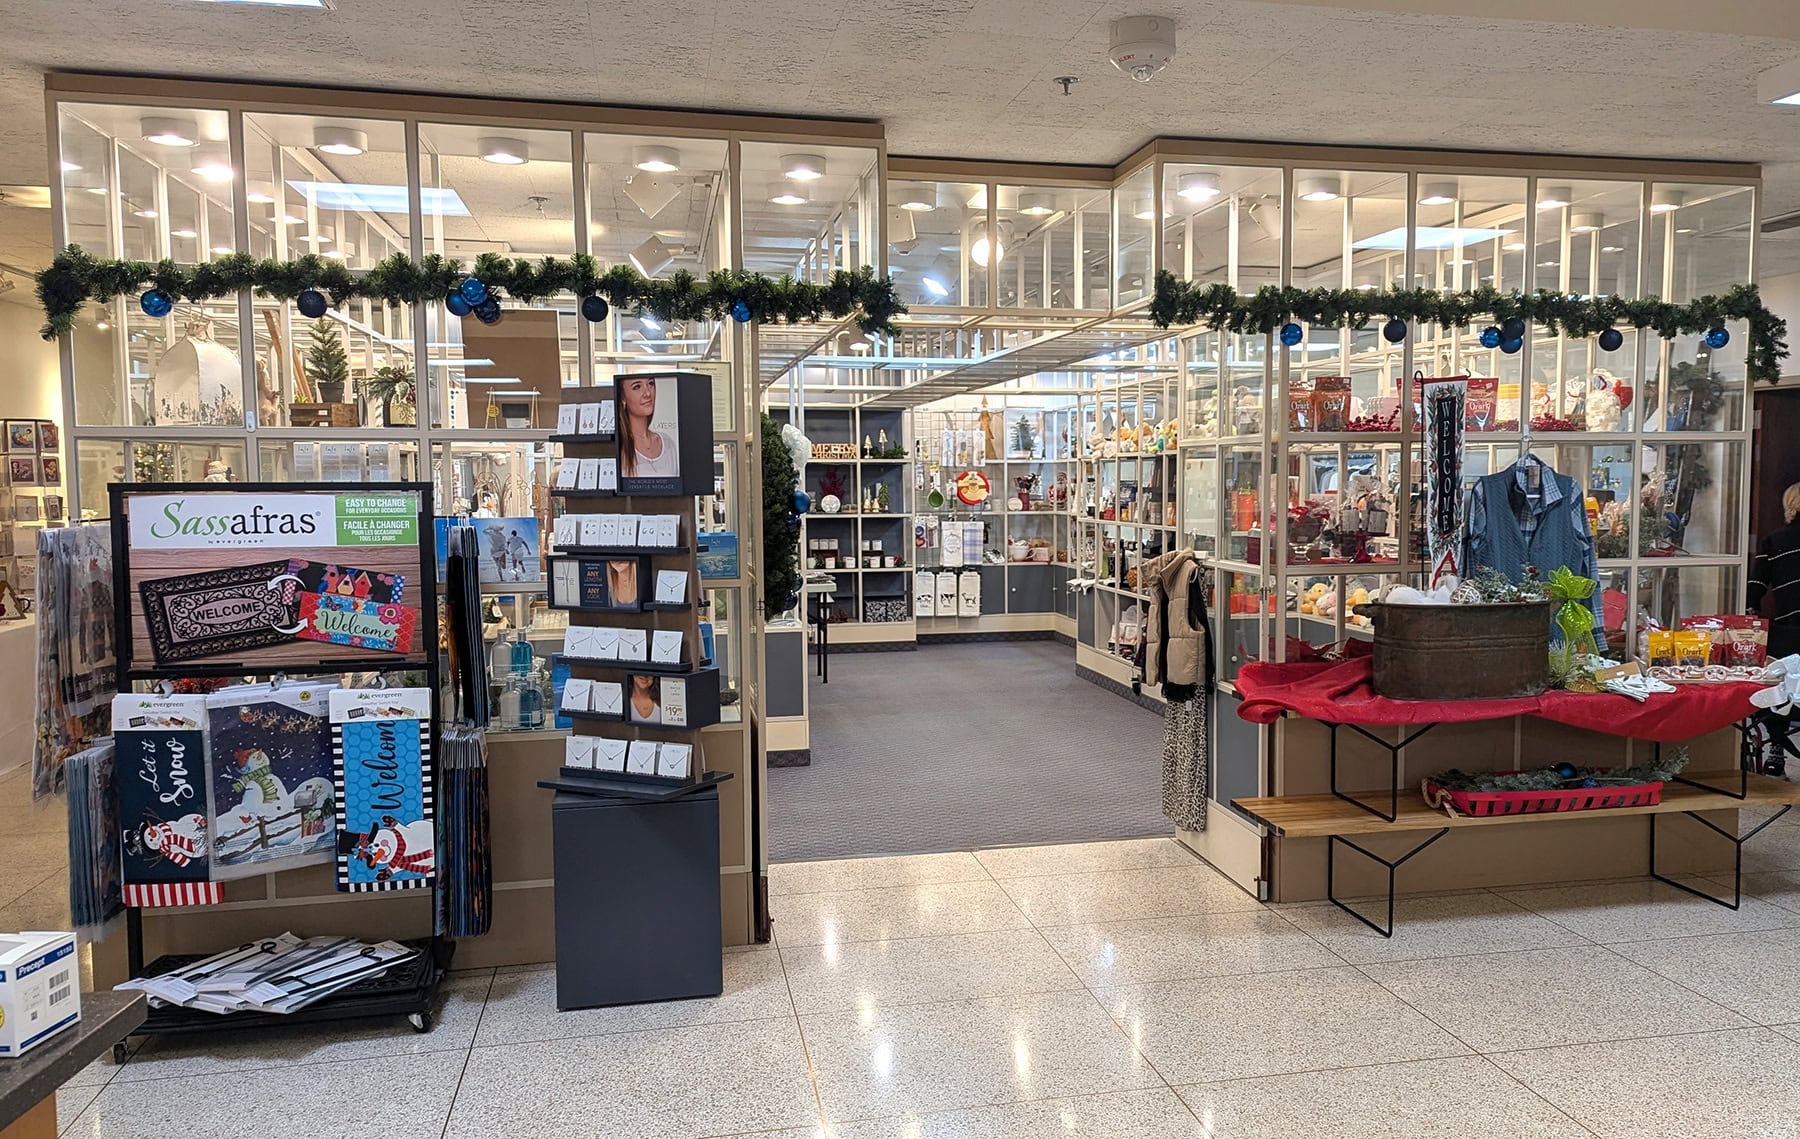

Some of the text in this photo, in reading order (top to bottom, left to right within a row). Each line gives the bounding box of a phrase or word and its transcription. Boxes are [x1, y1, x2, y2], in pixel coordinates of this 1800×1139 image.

[1441, 401, 1452, 532] WELCOME
[345, 498, 407, 508] EASY TO CHANGE
[343, 518, 410, 530] FACILE À CHANGER
[193, 601, 263, 621] WELCOME
[320, 611, 393, 639] Welcome
[1732, 641, 1758, 652] Ozark
[138, 738, 161, 793] Let it
[159, 737, 194, 807] Snow
[361, 720, 405, 810] Welcom
[18, 957, 46, 976] Precept
